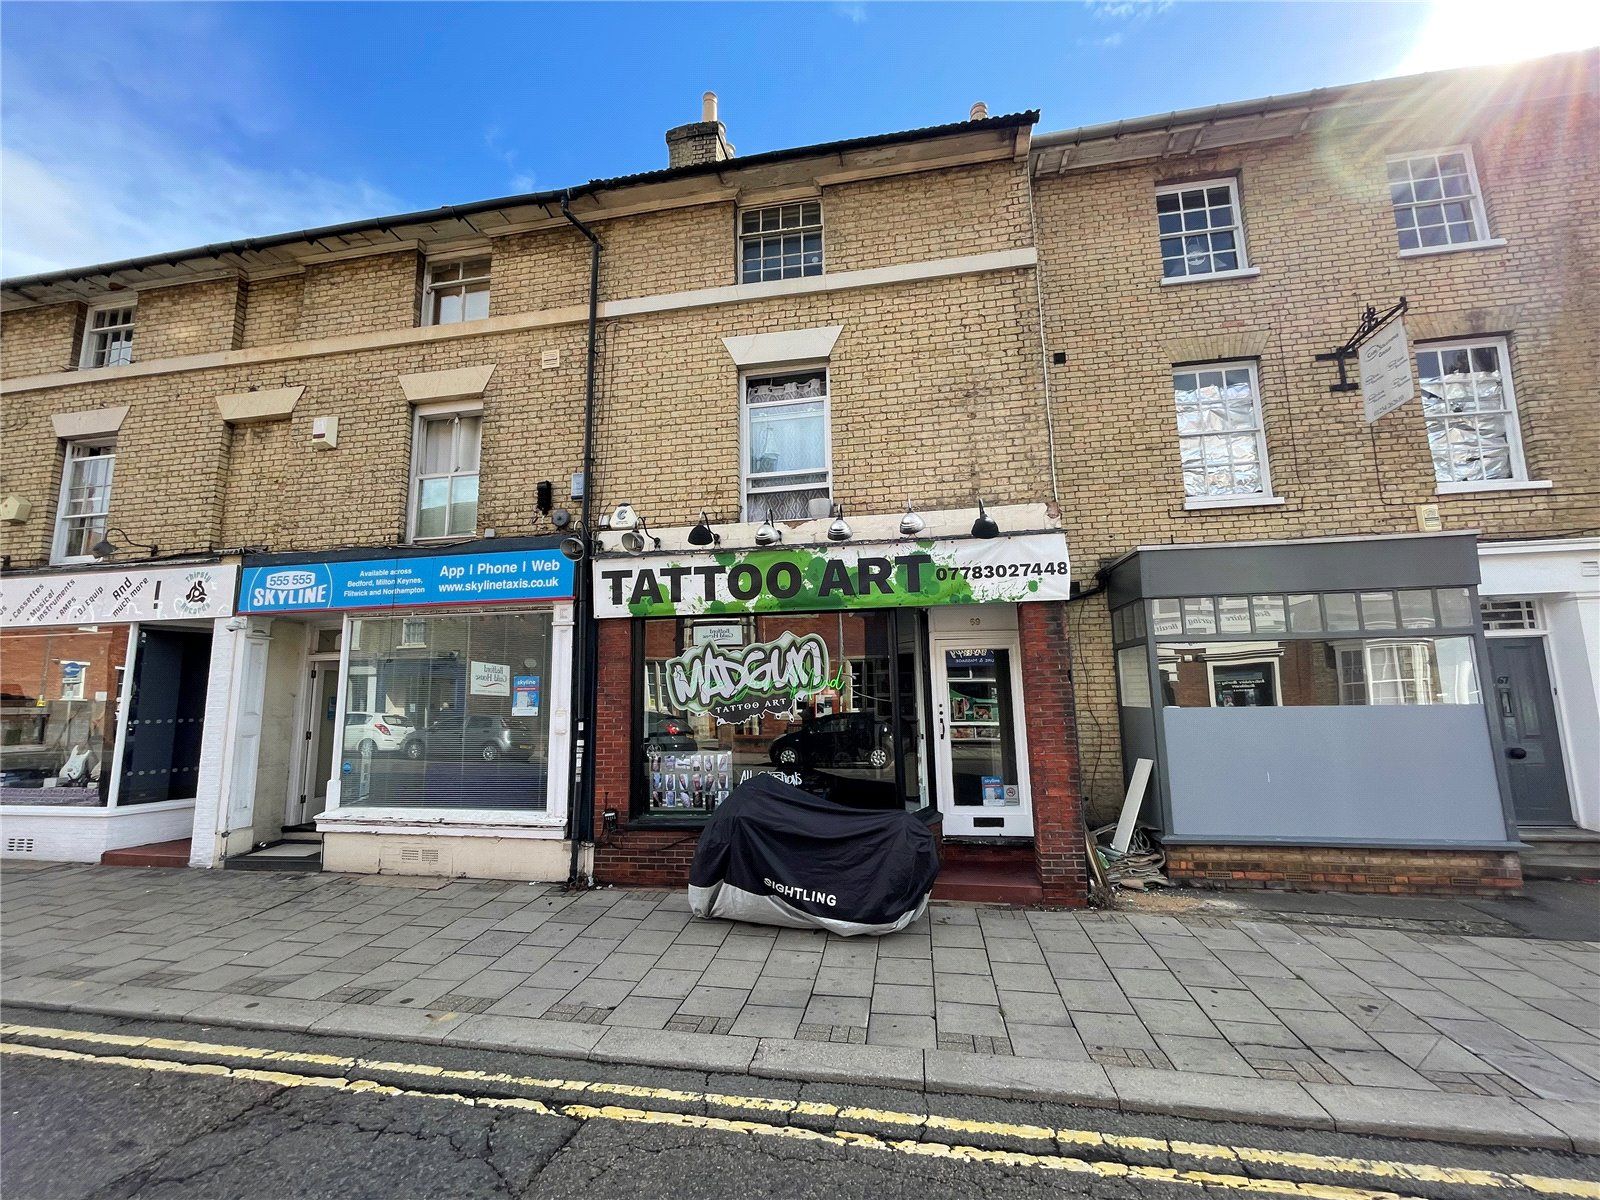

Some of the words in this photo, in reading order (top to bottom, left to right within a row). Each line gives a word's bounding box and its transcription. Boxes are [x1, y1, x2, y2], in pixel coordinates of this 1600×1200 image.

[185, 571, 212, 583] Thirsty
[359, 569, 389, 577] Available
[390, 568, 412, 576] across
[439, 565, 465, 579] App
[477, 563, 518, 575] Phone
[531, 559, 560, 572] Web
[112, 576, 133, 601] And
[269, 575, 290, 587] 555
[292, 573, 313, 585] 555
[347, 580, 375, 588] Bedford,
[396, 577, 424, 586] Keynes,
[438, 577, 559, 593] www.skylinetaxis.co.uk
[601, 561, 802, 606] TATTOO
[817, 554, 932, 597] ART
[935, 561, 1068, 581] 07783027448
[12, 583, 45, 619] Cassettes
[37, 578, 76, 622] Instruments
[85, 586, 104, 606] Equip
[112, 597, 131, 618] much
[130, 577, 149, 598] more
[253, 584, 328, 607] SKYLINE
[369, 588, 381, 596] and
[382, 587, 426, 596] Northampton
[29, 588, 55, 618] Musical
[715, 701, 760, 714] TATTOO
[764, 698, 787, 708] ART
[763, 877, 837, 907] SIGHTLING
